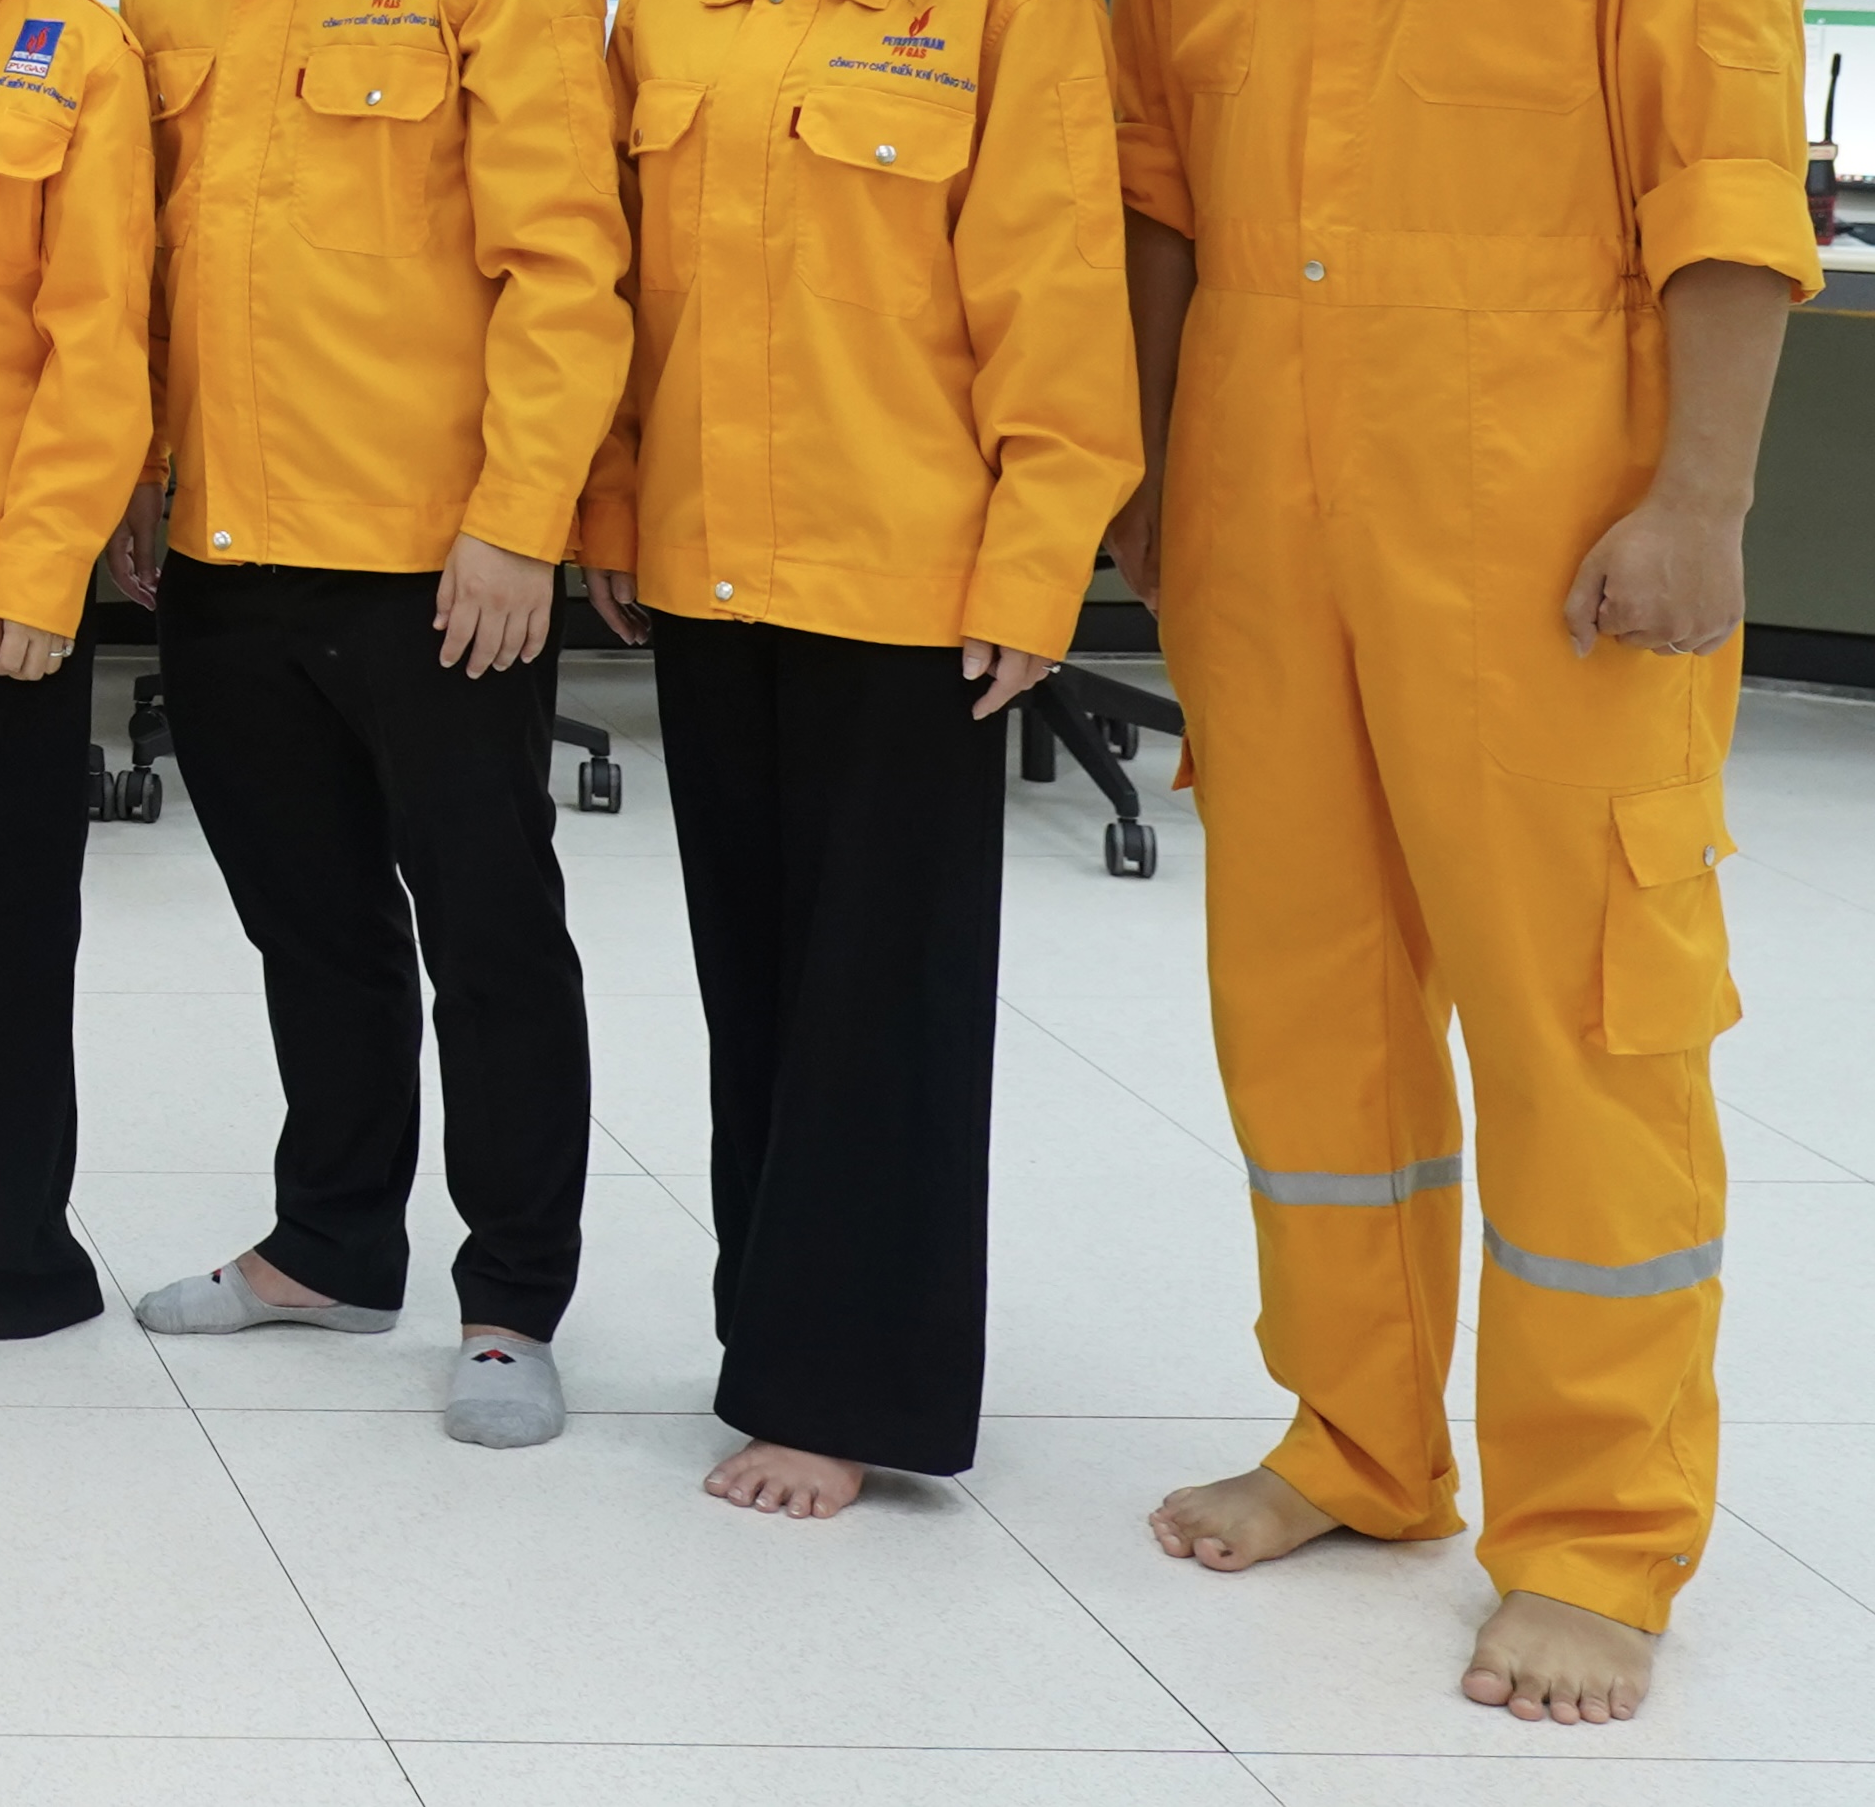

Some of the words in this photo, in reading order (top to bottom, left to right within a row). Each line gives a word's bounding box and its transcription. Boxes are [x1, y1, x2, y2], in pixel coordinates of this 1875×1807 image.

[891, 47, 906, 57] PV
[906, 48, 929, 59] GAS
[7, 61, 25, 72] PV
[25, 63, 47, 75] GAS
